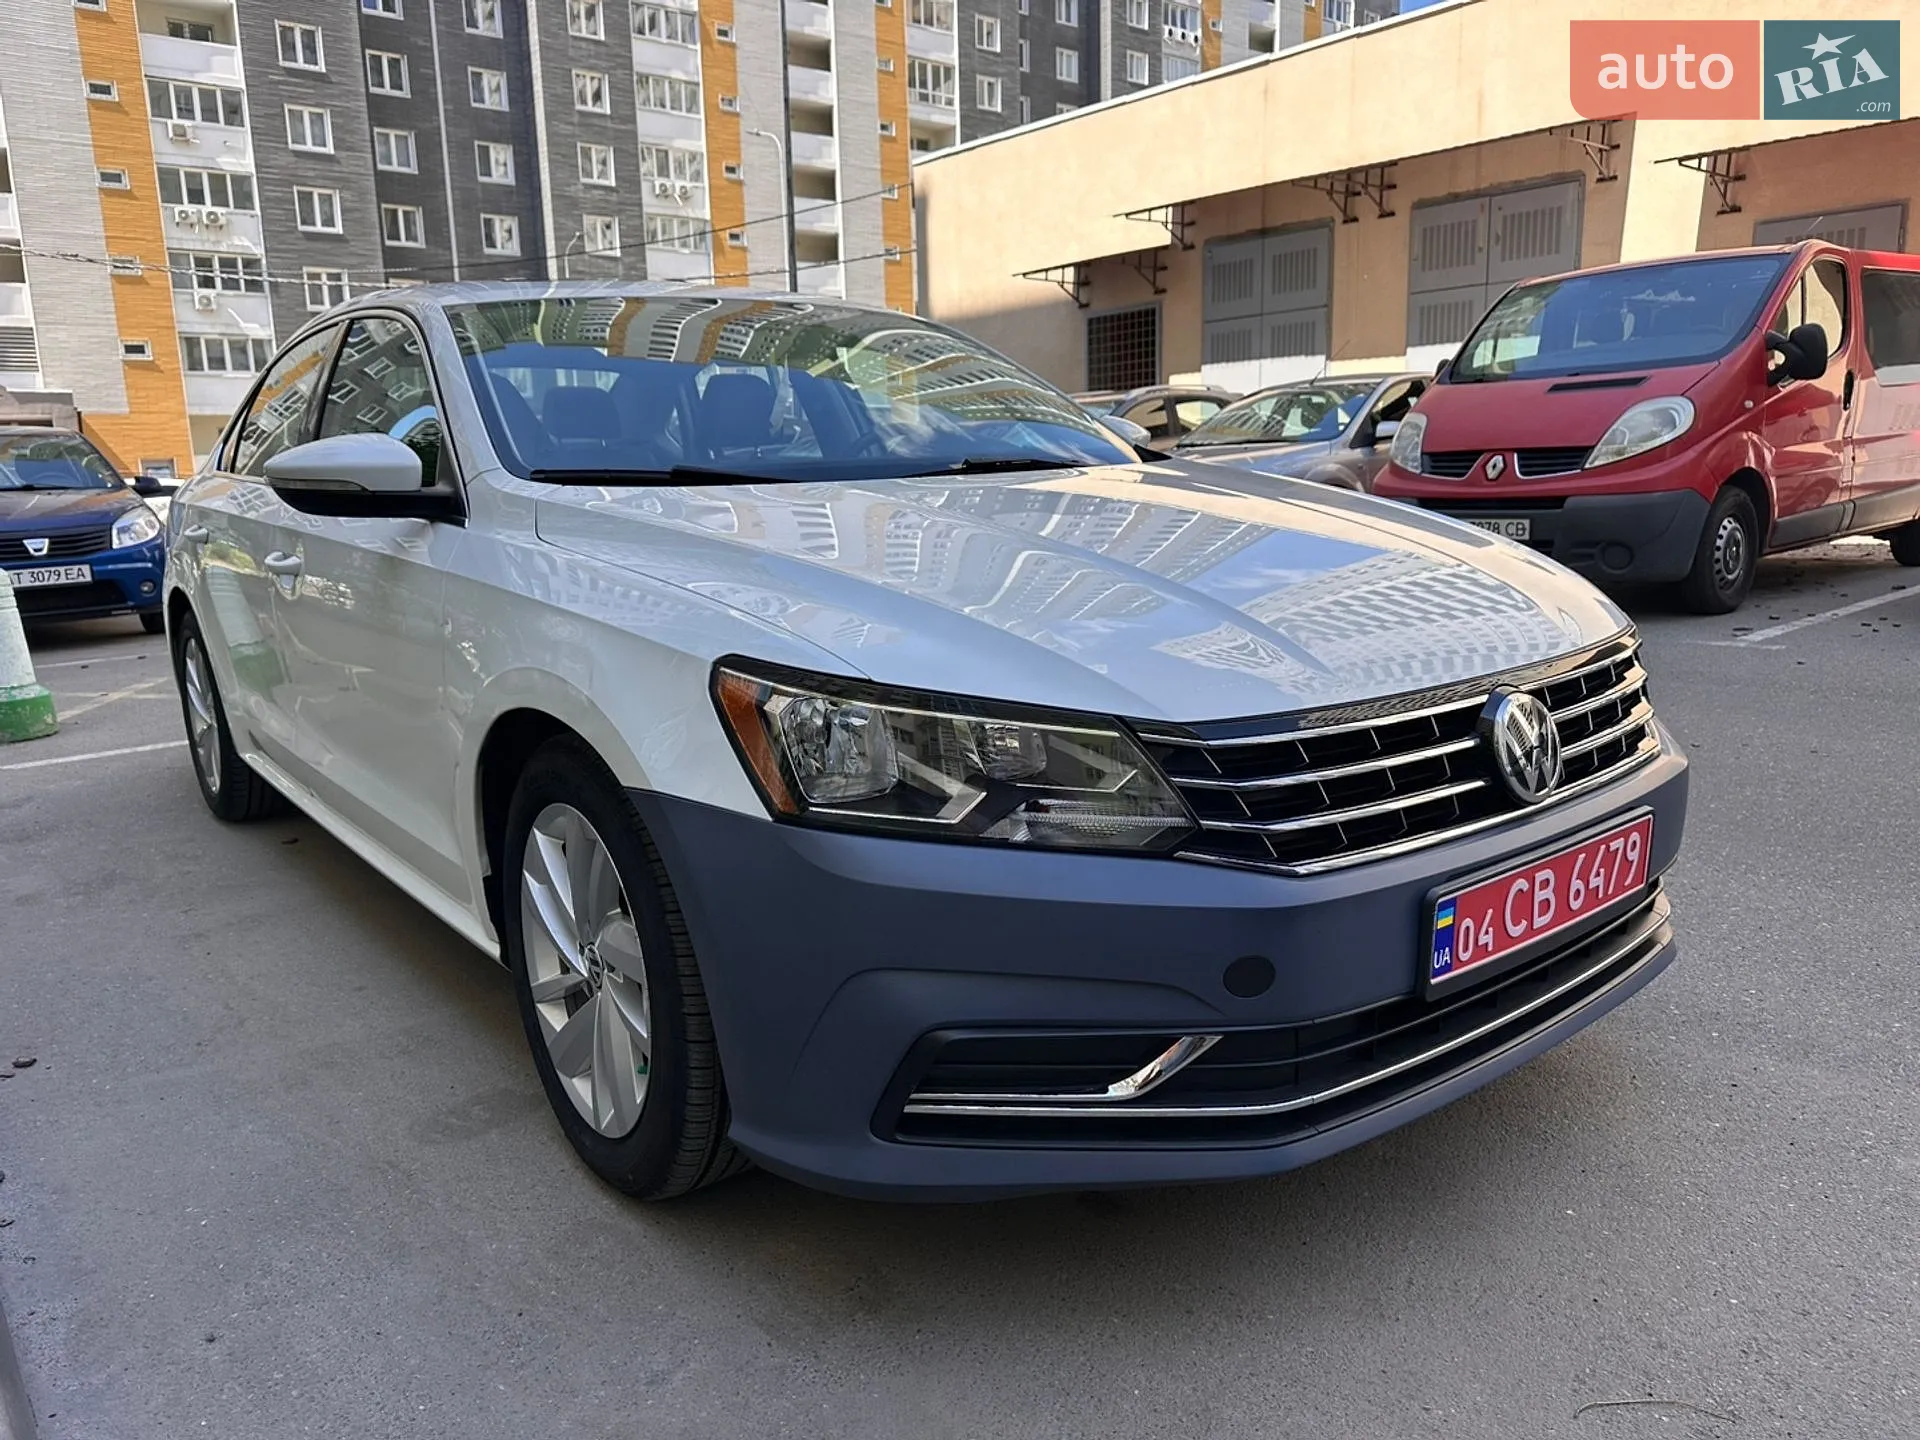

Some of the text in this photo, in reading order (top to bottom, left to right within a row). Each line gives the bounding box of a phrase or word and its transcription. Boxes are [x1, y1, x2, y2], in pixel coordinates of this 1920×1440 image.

[28, 569, 61, 584] 3079
[64, 567, 86, 581] EA
[1457, 831, 1641, 962] 04 CB 6479
[1434, 947, 1451, 969] UA
